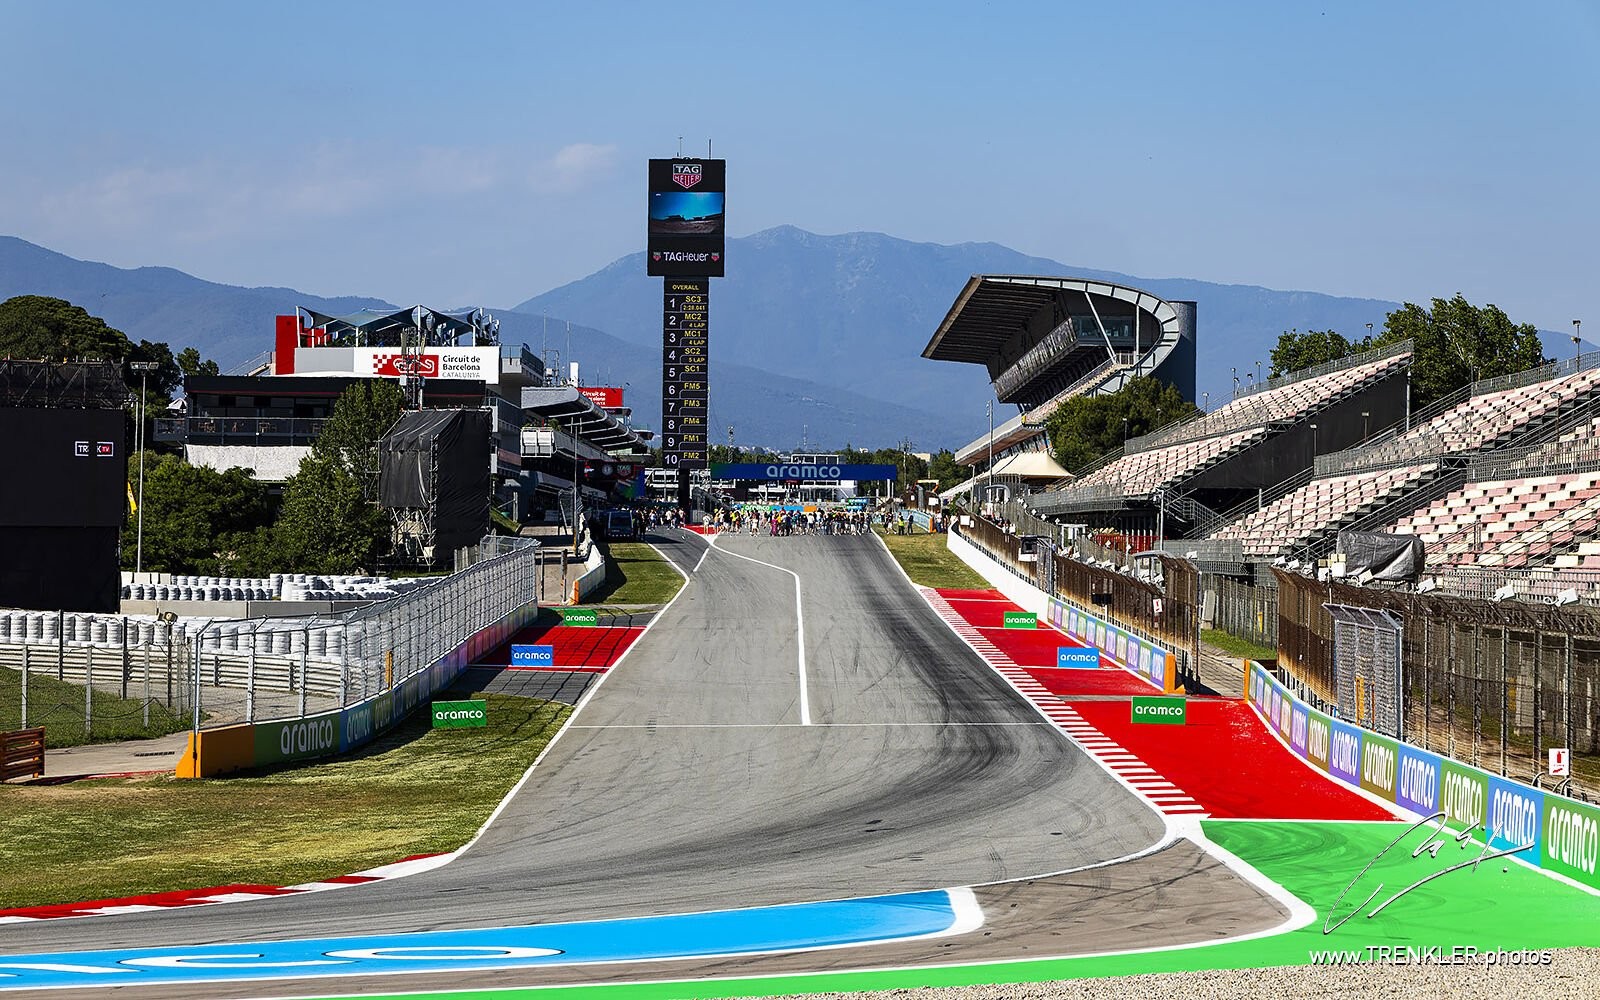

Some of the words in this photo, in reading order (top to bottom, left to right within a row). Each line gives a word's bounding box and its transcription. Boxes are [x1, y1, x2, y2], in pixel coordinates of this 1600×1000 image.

[674, 174, 700, 186] HEUER
[670, 298, 675, 308] 1
[670, 316, 676, 325] 2
[669, 333, 676, 342] 3
[669, 350, 676, 360] 4
[669, 368, 676, 377] 5
[668, 385, 675, 395] 6
[668, 403, 675, 412] 7
[668, 420, 674, 429] 8
[668, 437, 674, 446] 9
[665, 454, 677, 464] 10
[766, 465, 840, 478] aramco
[436, 710, 483, 720] aramco
[1135, 705, 1183, 716] aramco
[281, 720, 333, 754] aramco
[1309, 718, 1328, 762] aramco
[1332, 730, 1358, 776] aramco
[1364, 742, 1394, 792] aramco
[1401, 755, 1435, 809] aramco
[1444, 771, 1482, 830] aramco
[1493, 788, 1536, 851] aramco
[1548, 806, 1598, 875] aramco
